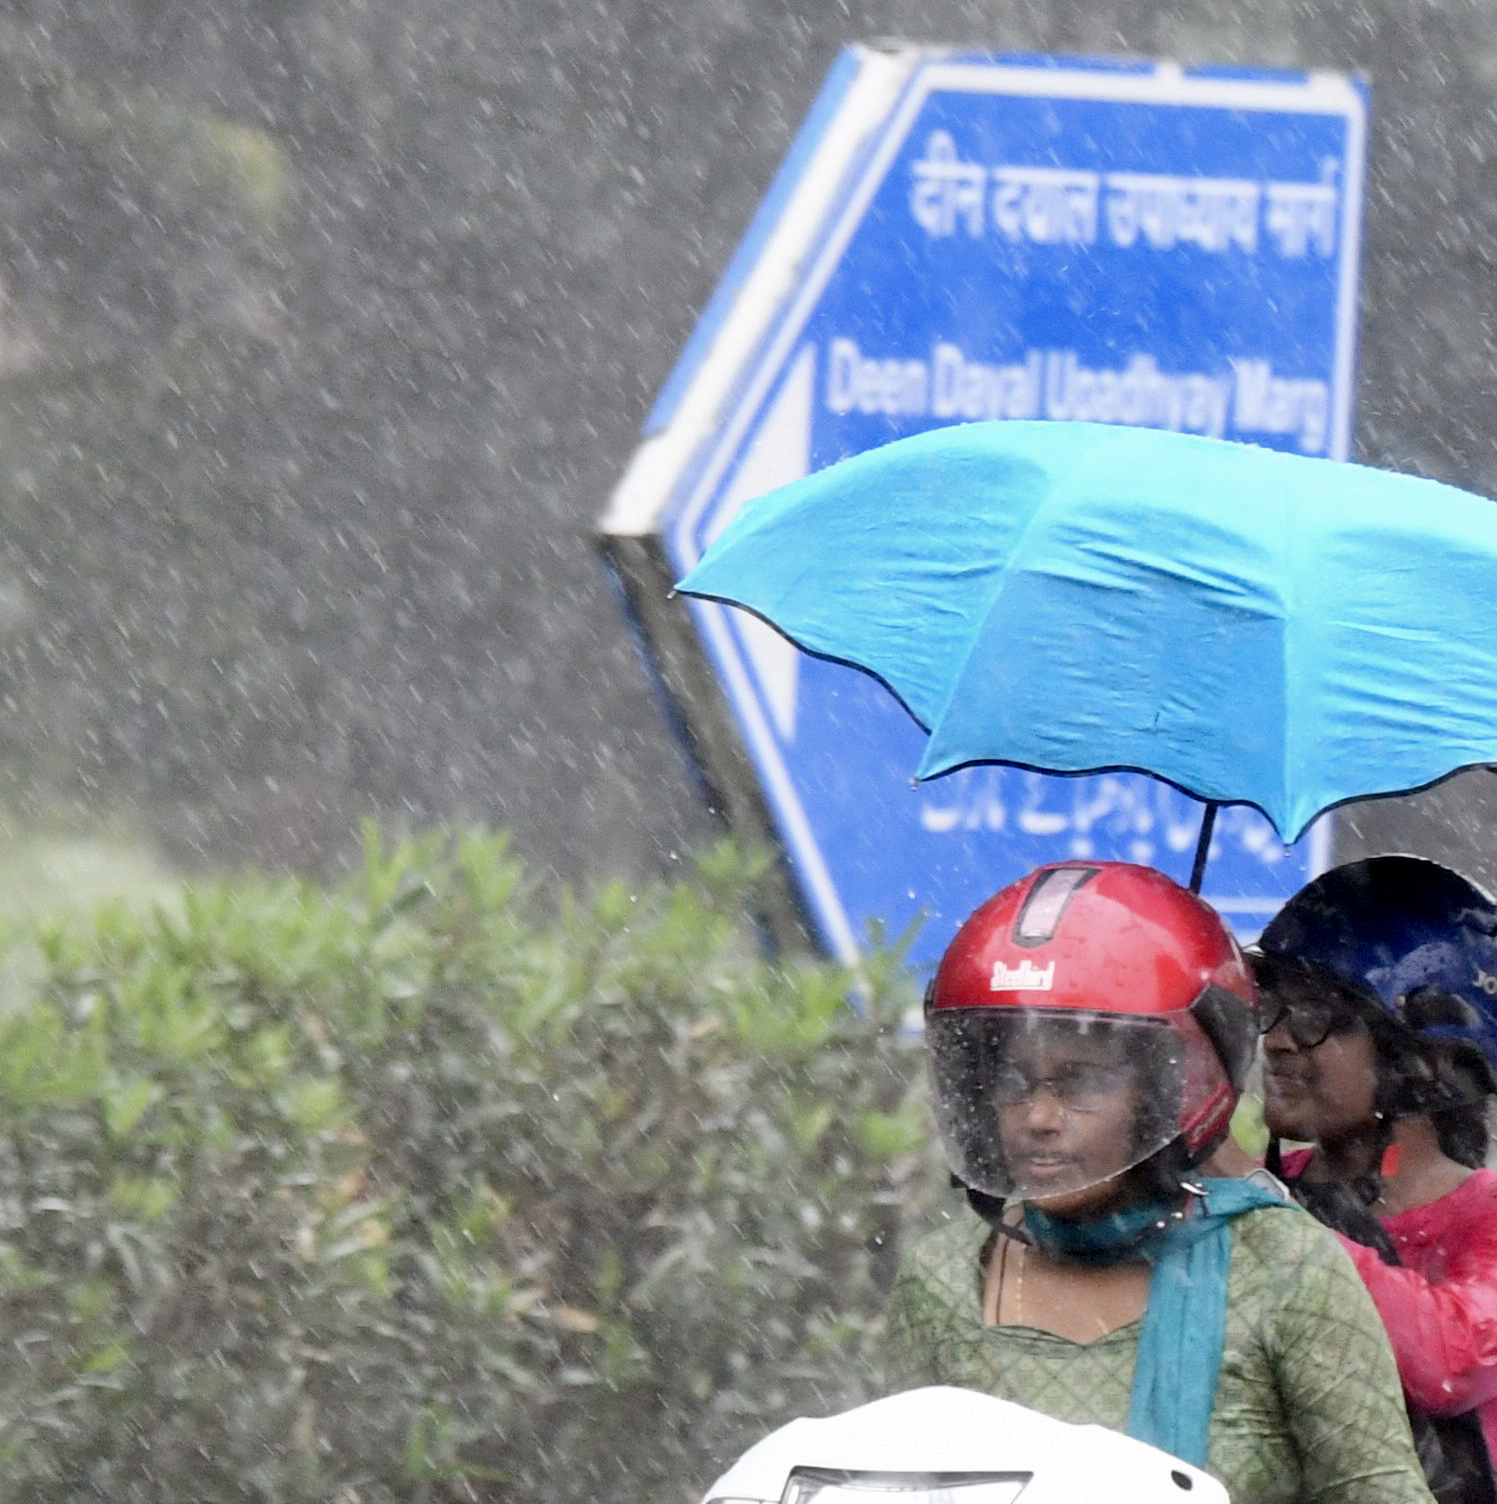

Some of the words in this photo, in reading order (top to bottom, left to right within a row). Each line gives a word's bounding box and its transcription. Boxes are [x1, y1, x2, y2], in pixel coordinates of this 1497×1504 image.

[828, 336, 928, 416] Deen
[932, 341, 1043, 421] Dayal
[1233, 356, 1329, 453] Marg
